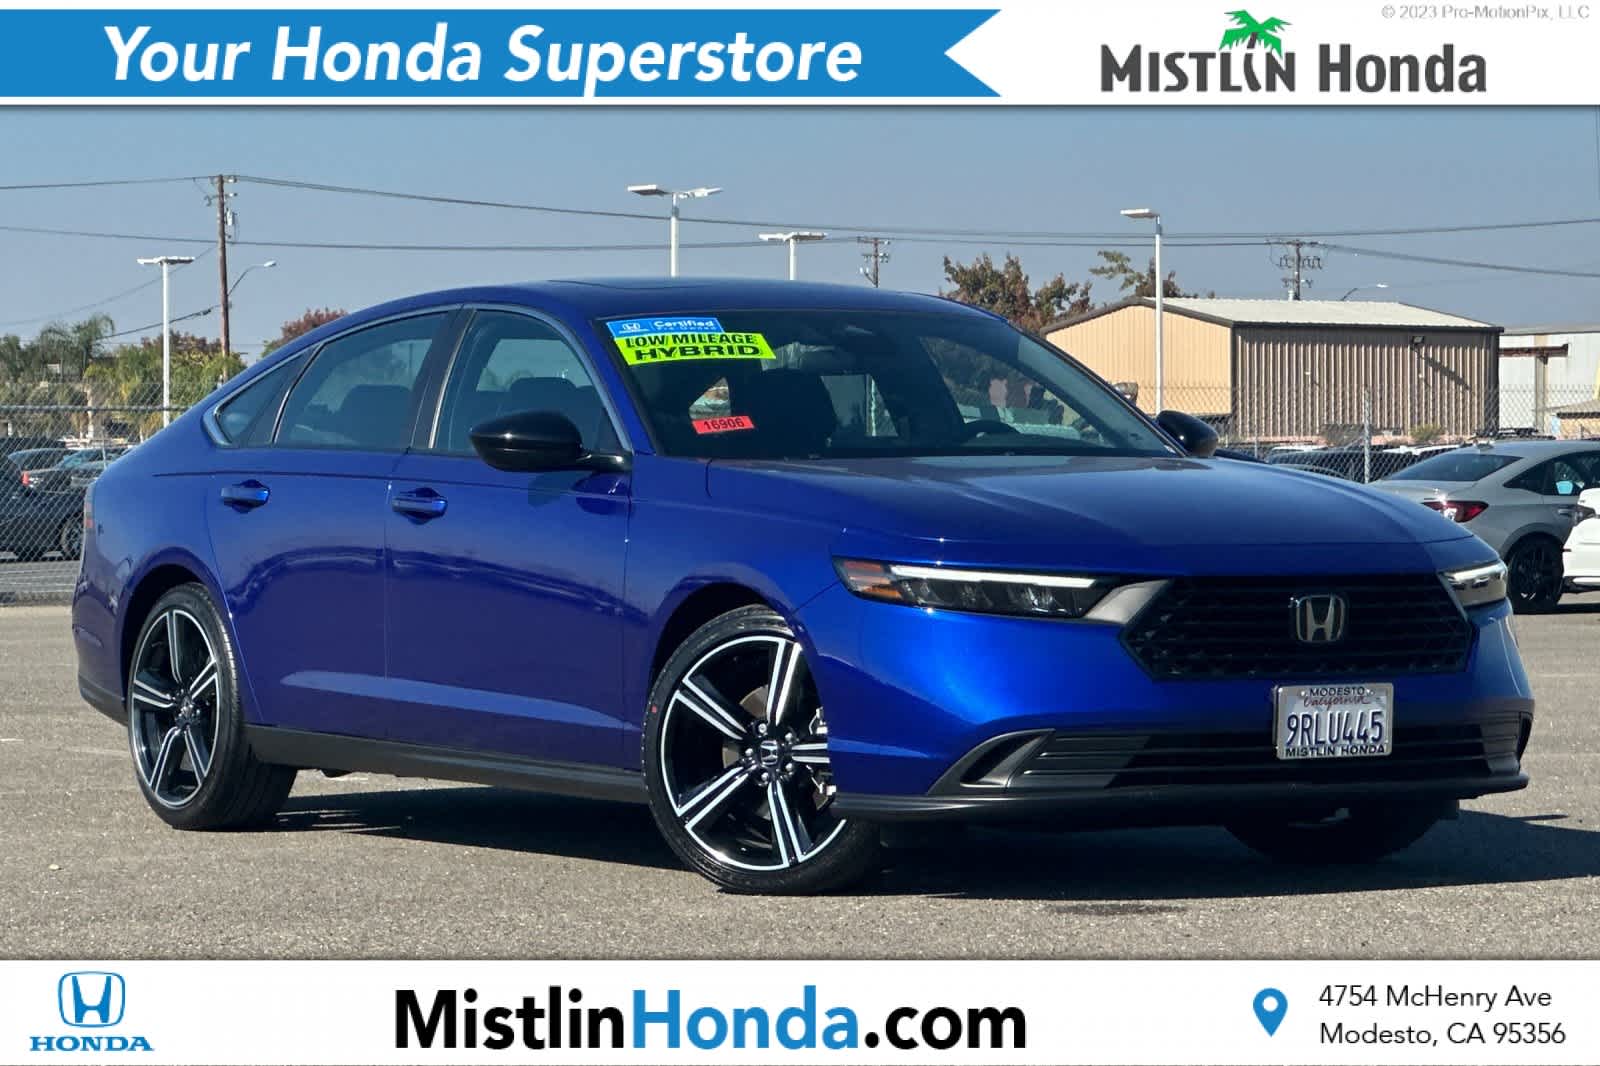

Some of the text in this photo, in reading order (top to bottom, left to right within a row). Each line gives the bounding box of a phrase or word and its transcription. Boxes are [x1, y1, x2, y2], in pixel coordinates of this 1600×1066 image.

[653, 320, 714, 329] Certified
[625, 333, 754, 348] LOW MILEAGE
[635, 346, 760, 361] HYBRID
[704, 418, 744, 430] 16906
[1309, 686, 1365, 697] MODESTO
[1303, 696, 1371, 711] California
[1286, 710, 1383, 746] 9RLU445
[1285, 744, 1385, 757] MISTLIN HONDA
